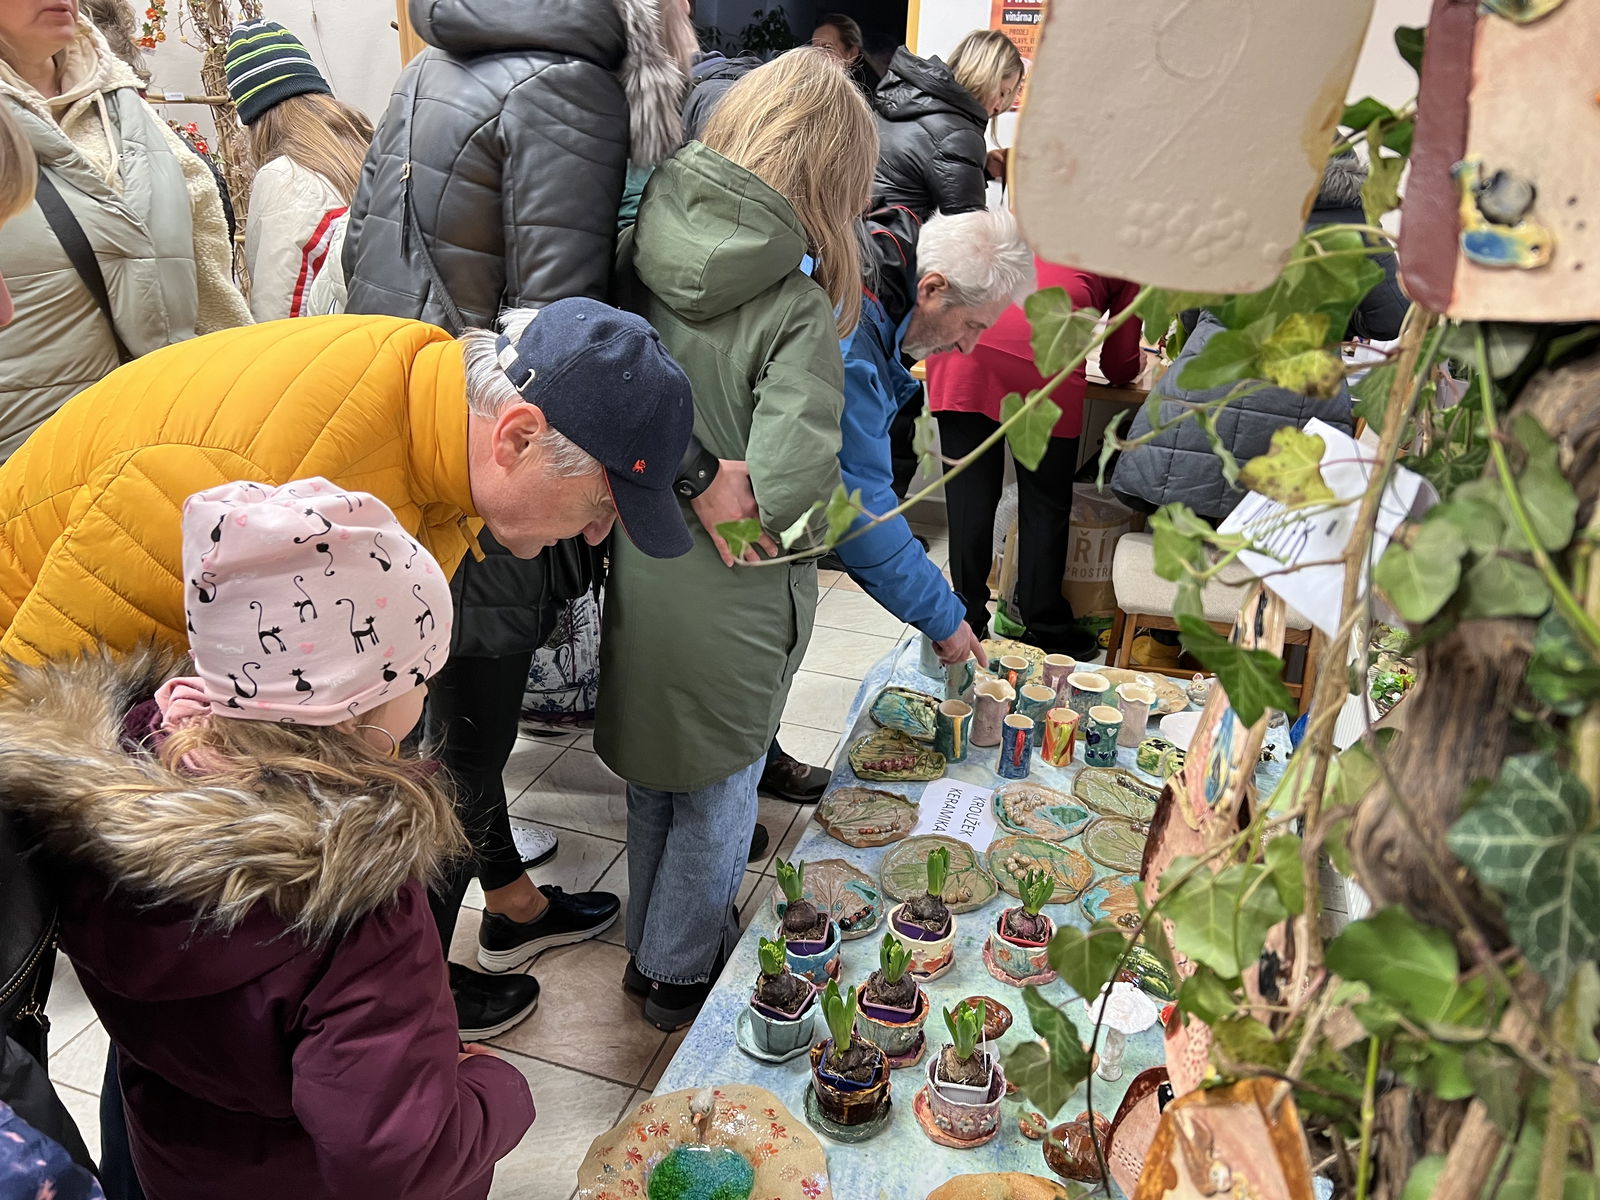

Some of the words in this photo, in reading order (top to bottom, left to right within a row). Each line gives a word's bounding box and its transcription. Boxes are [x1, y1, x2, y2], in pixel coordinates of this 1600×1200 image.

[1005, 11, 1032, 21] vinárna
[1073, 529, 1118, 564] ŘÍ
[932, 787, 963, 832] KERAMIKA
[959, 795, 987, 837] KROUŽEK
